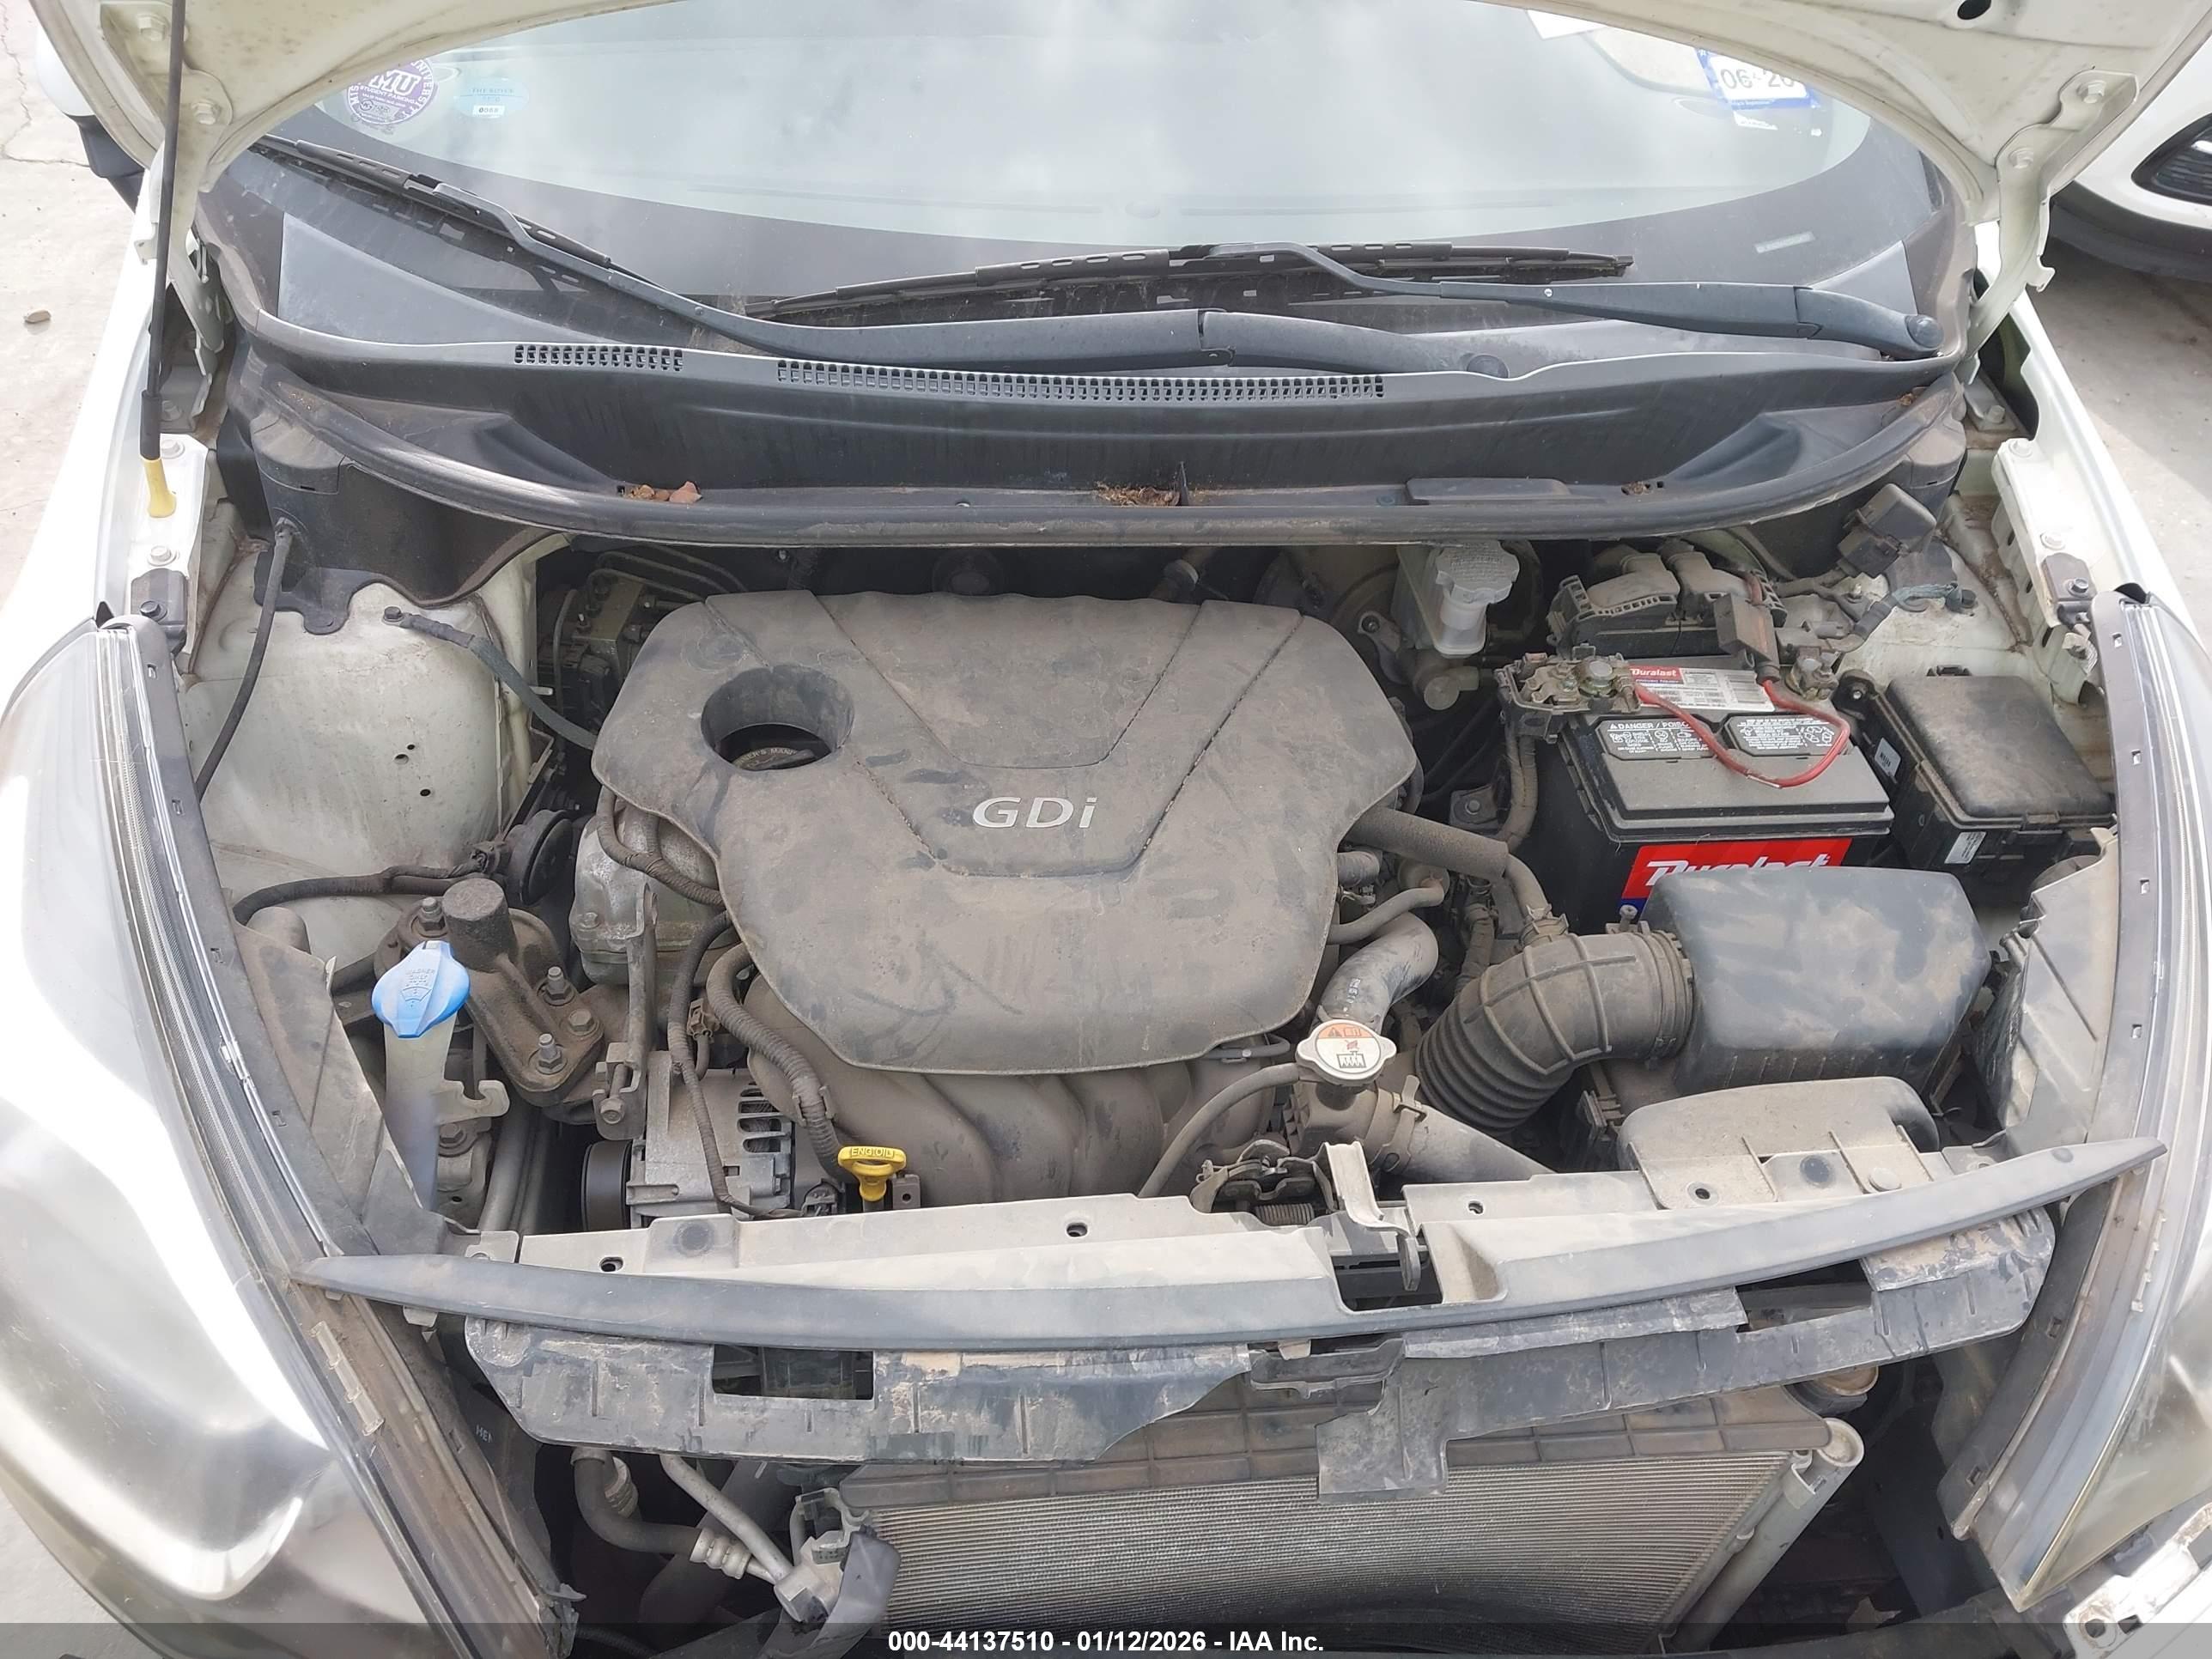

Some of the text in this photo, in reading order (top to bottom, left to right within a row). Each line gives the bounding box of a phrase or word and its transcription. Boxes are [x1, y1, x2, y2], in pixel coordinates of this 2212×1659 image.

[360, 85, 387, 98] STUDENT
[387, 93, 417, 106] PARKING
[1631, 668, 1678, 678] Duralast
[973, 797, 1097, 828] GDi
[851, 1147, 894, 1158] ENG OIL
